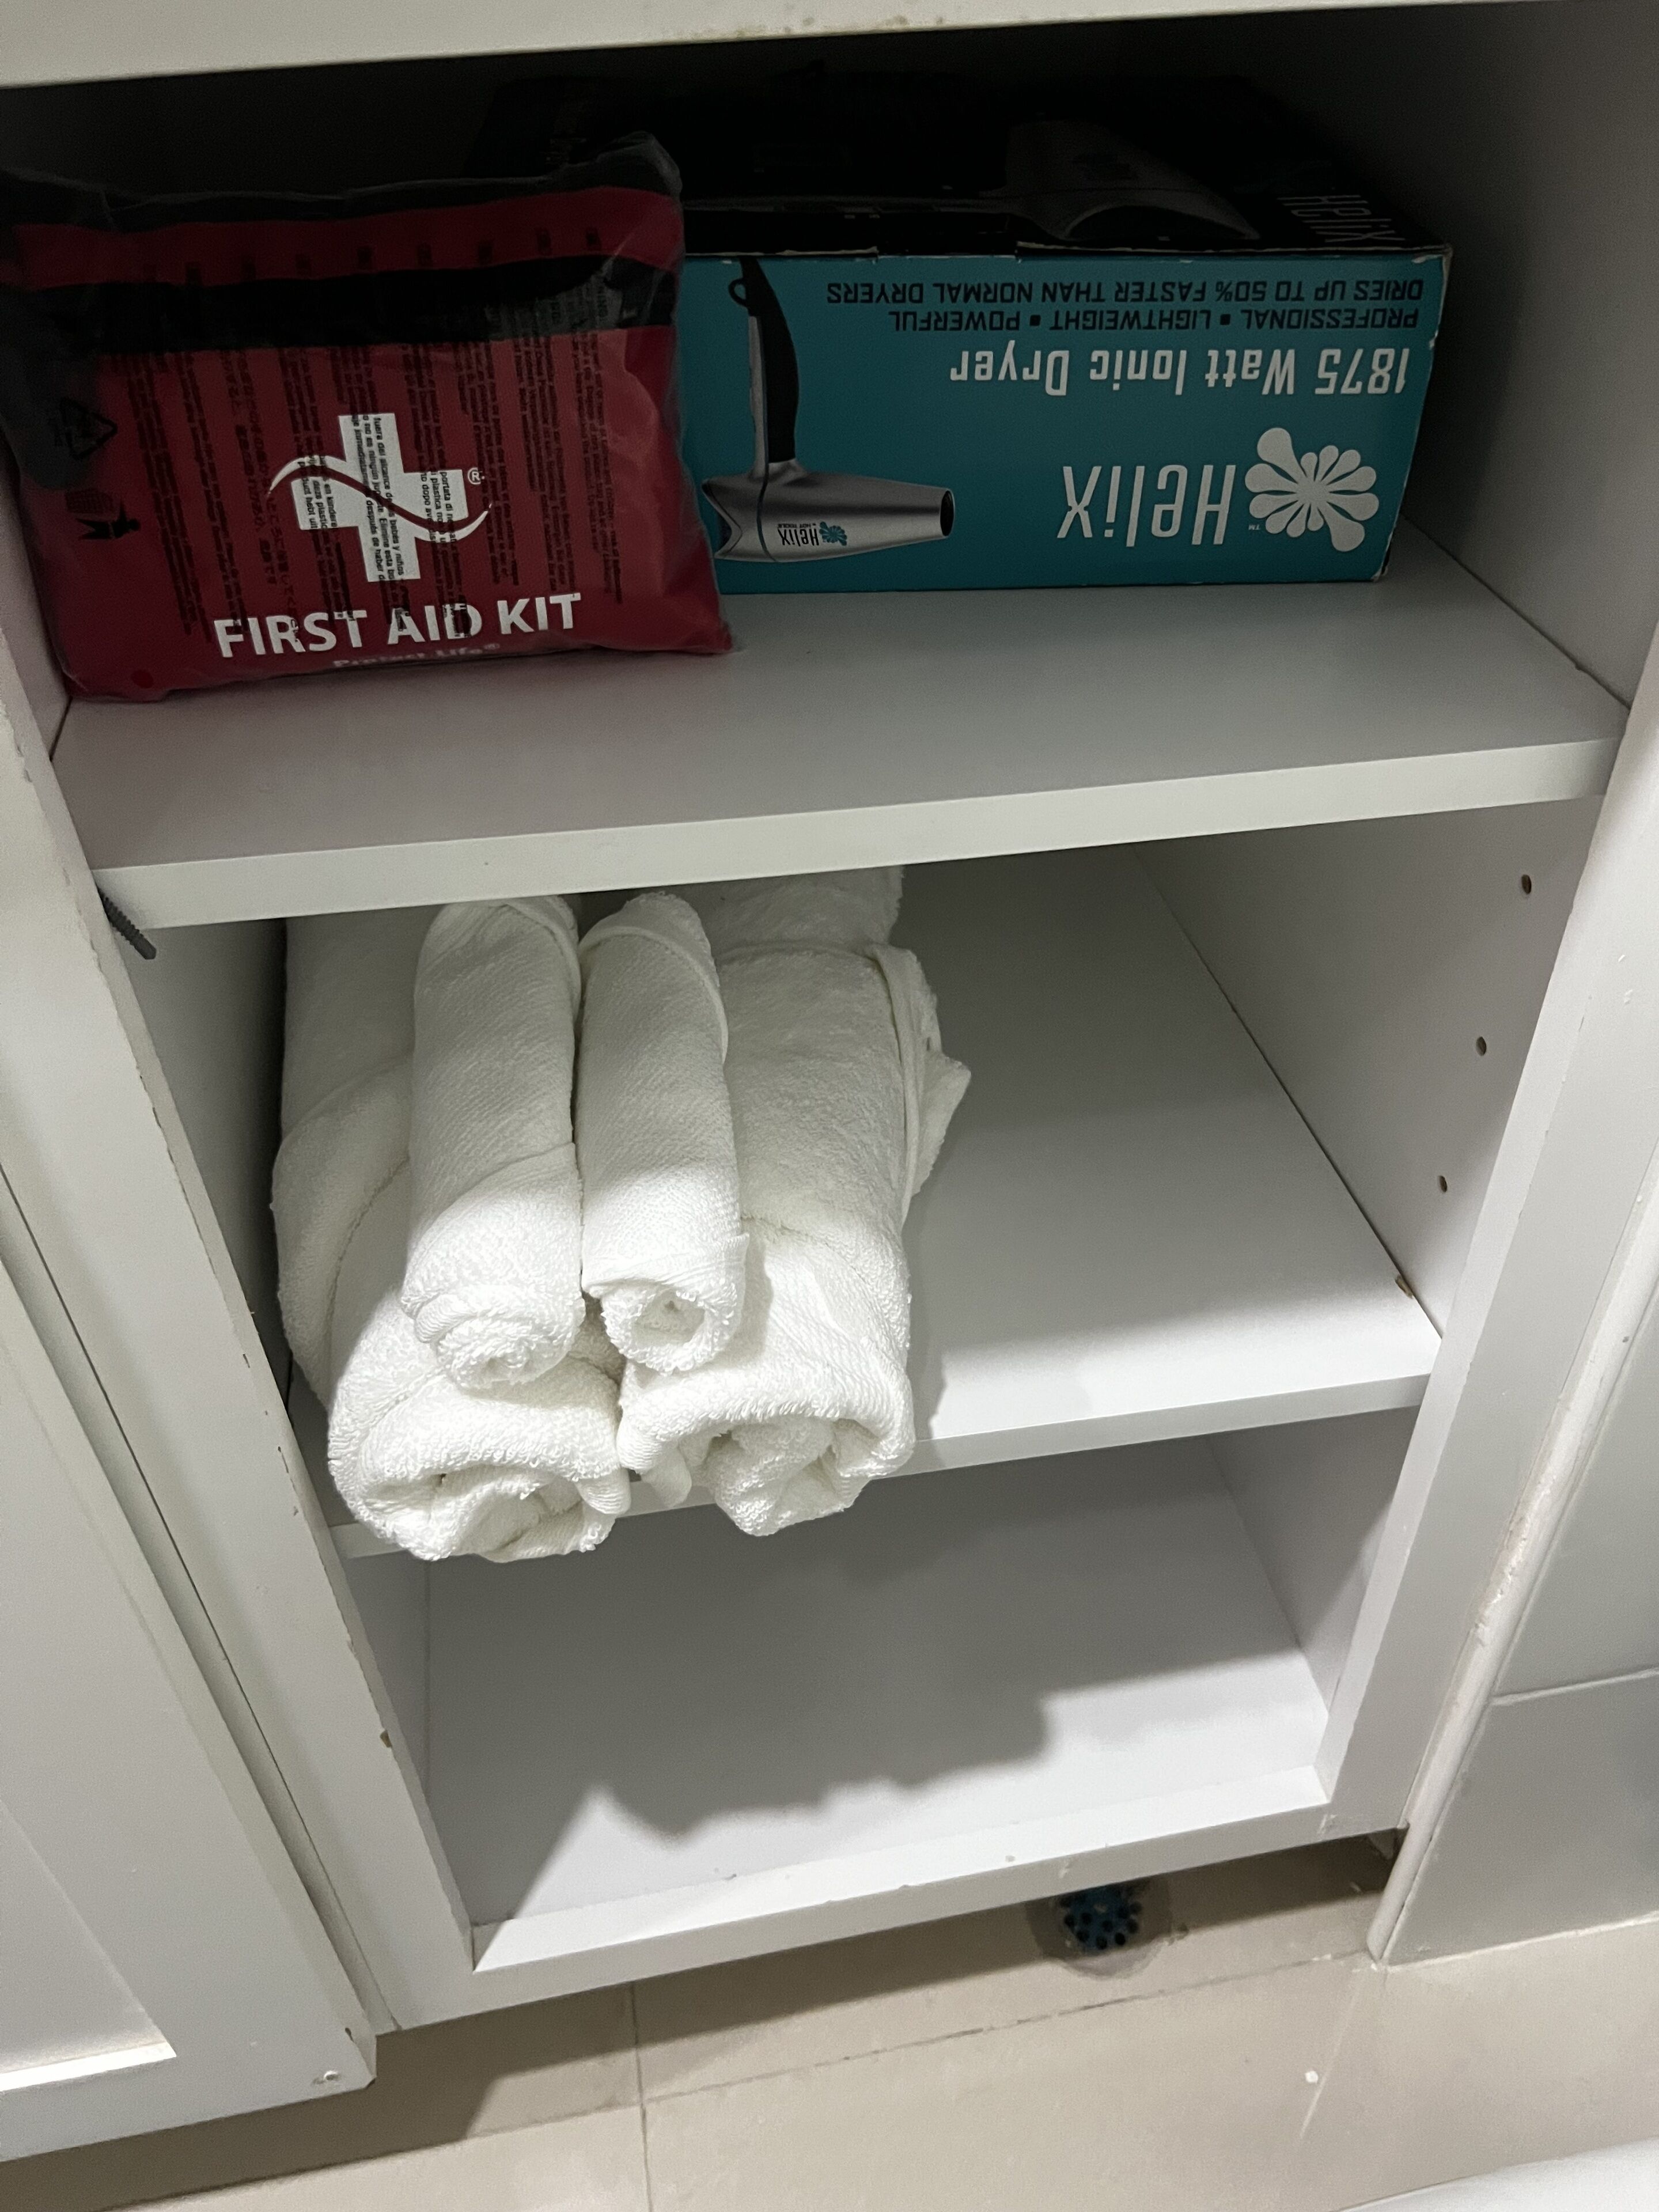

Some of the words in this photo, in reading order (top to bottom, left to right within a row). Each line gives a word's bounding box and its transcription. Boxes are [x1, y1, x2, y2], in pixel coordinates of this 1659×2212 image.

[827, 282, 924, 305] DRYERS
[931, 282, 1032, 304] NORMAL
[1041, 282, 1106, 303] THAN
[1113, 282, 1206, 304] FASTER
[1214, 280, 1267, 302] 50%
[1276, 281, 1305, 302] TO
[1313, 281, 1347, 302] UP
[1355, 279, 1424, 304] DRIES
[888, 310, 1020, 331] POWERFUL
[1050, 309, 1212, 329] LIGHTWEIGHT
[1240, 307, 1419, 330] PROFESSIONAL
[950, 341, 1069, 396] Dryer
[1090, 349, 1187, 395] Ionic
[1206, 349, 1296, 394] Watt
[1315, 348, 1410, 394] 1875
[1057, 465, 1236, 547] Helix
[778, 528, 819, 547] Helix
[214, 609, 367, 658] FIRST
[387, 603, 483, 645] AID
[497, 593, 581, 635] KIT
